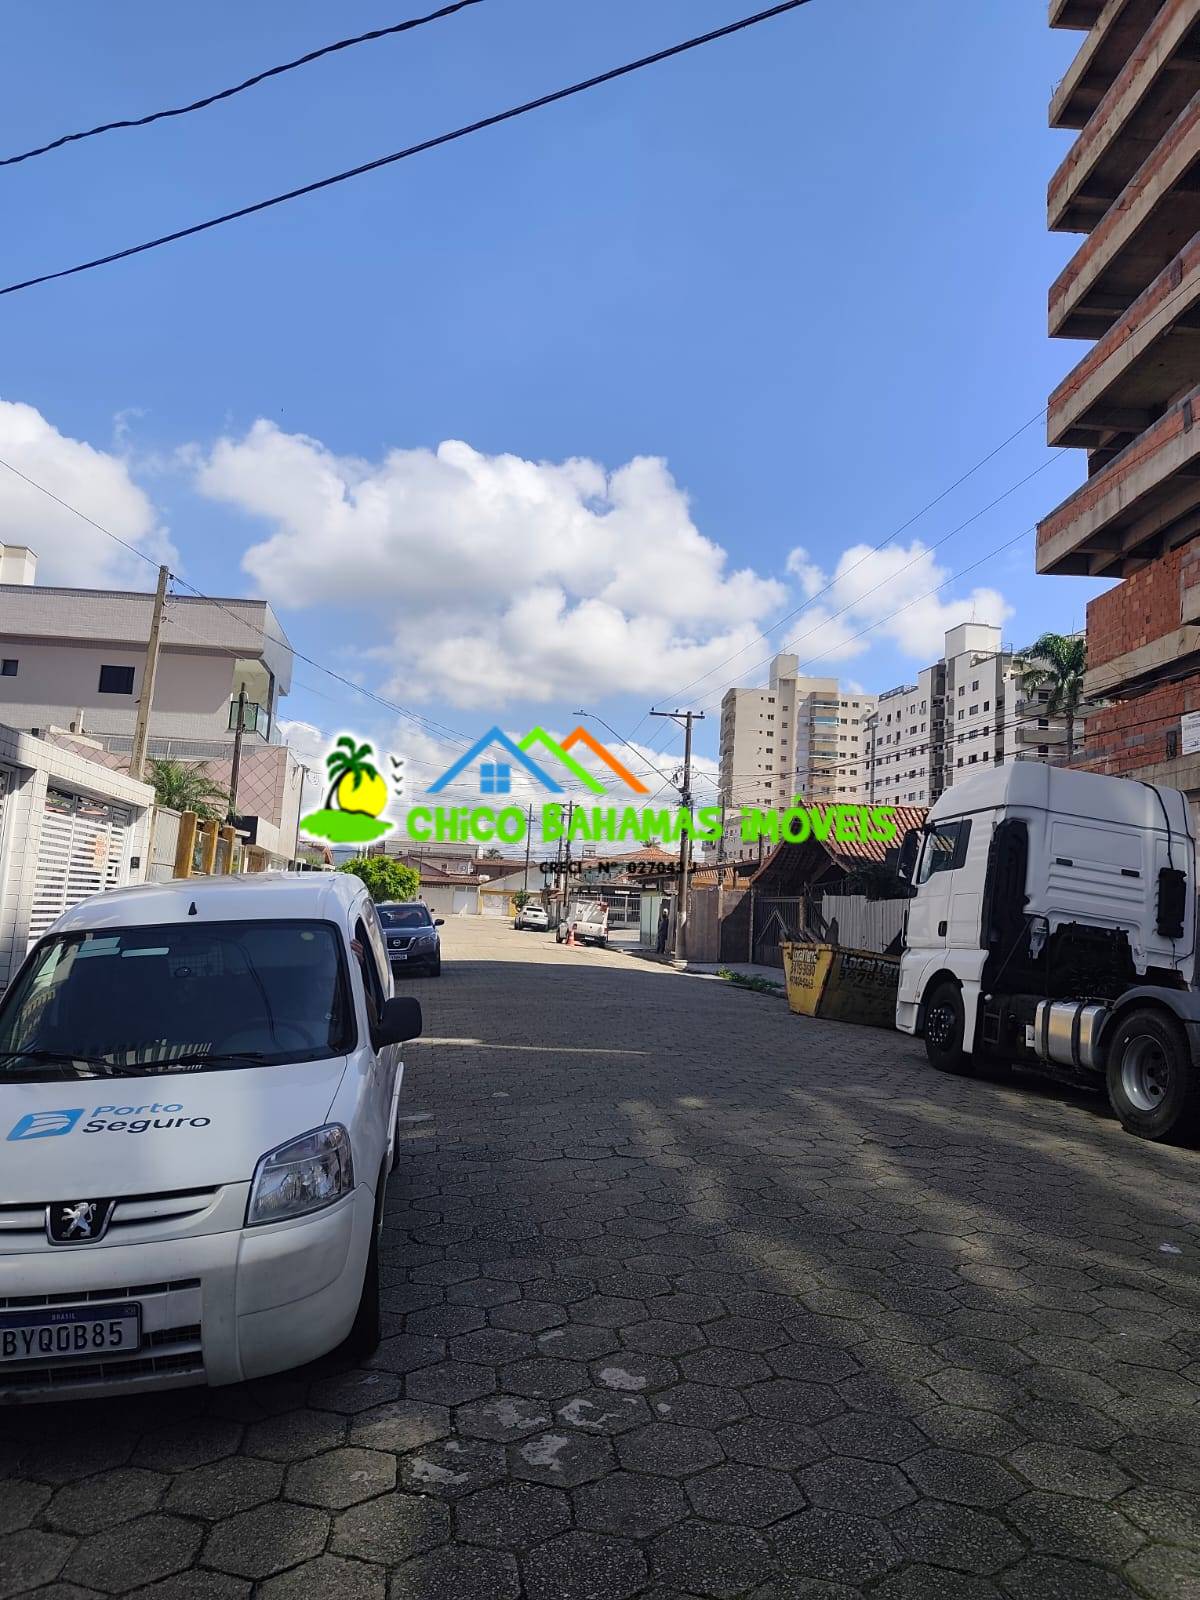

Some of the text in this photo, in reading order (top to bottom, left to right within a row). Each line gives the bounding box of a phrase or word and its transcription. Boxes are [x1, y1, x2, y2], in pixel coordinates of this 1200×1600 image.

[92, 1103, 184, 1118] Porto
[82, 1117, 211, 1134] Seguro
[51, 1312, 76, 1321] BRASIL
[2, 1321, 123, 1356] BYQ0B85
